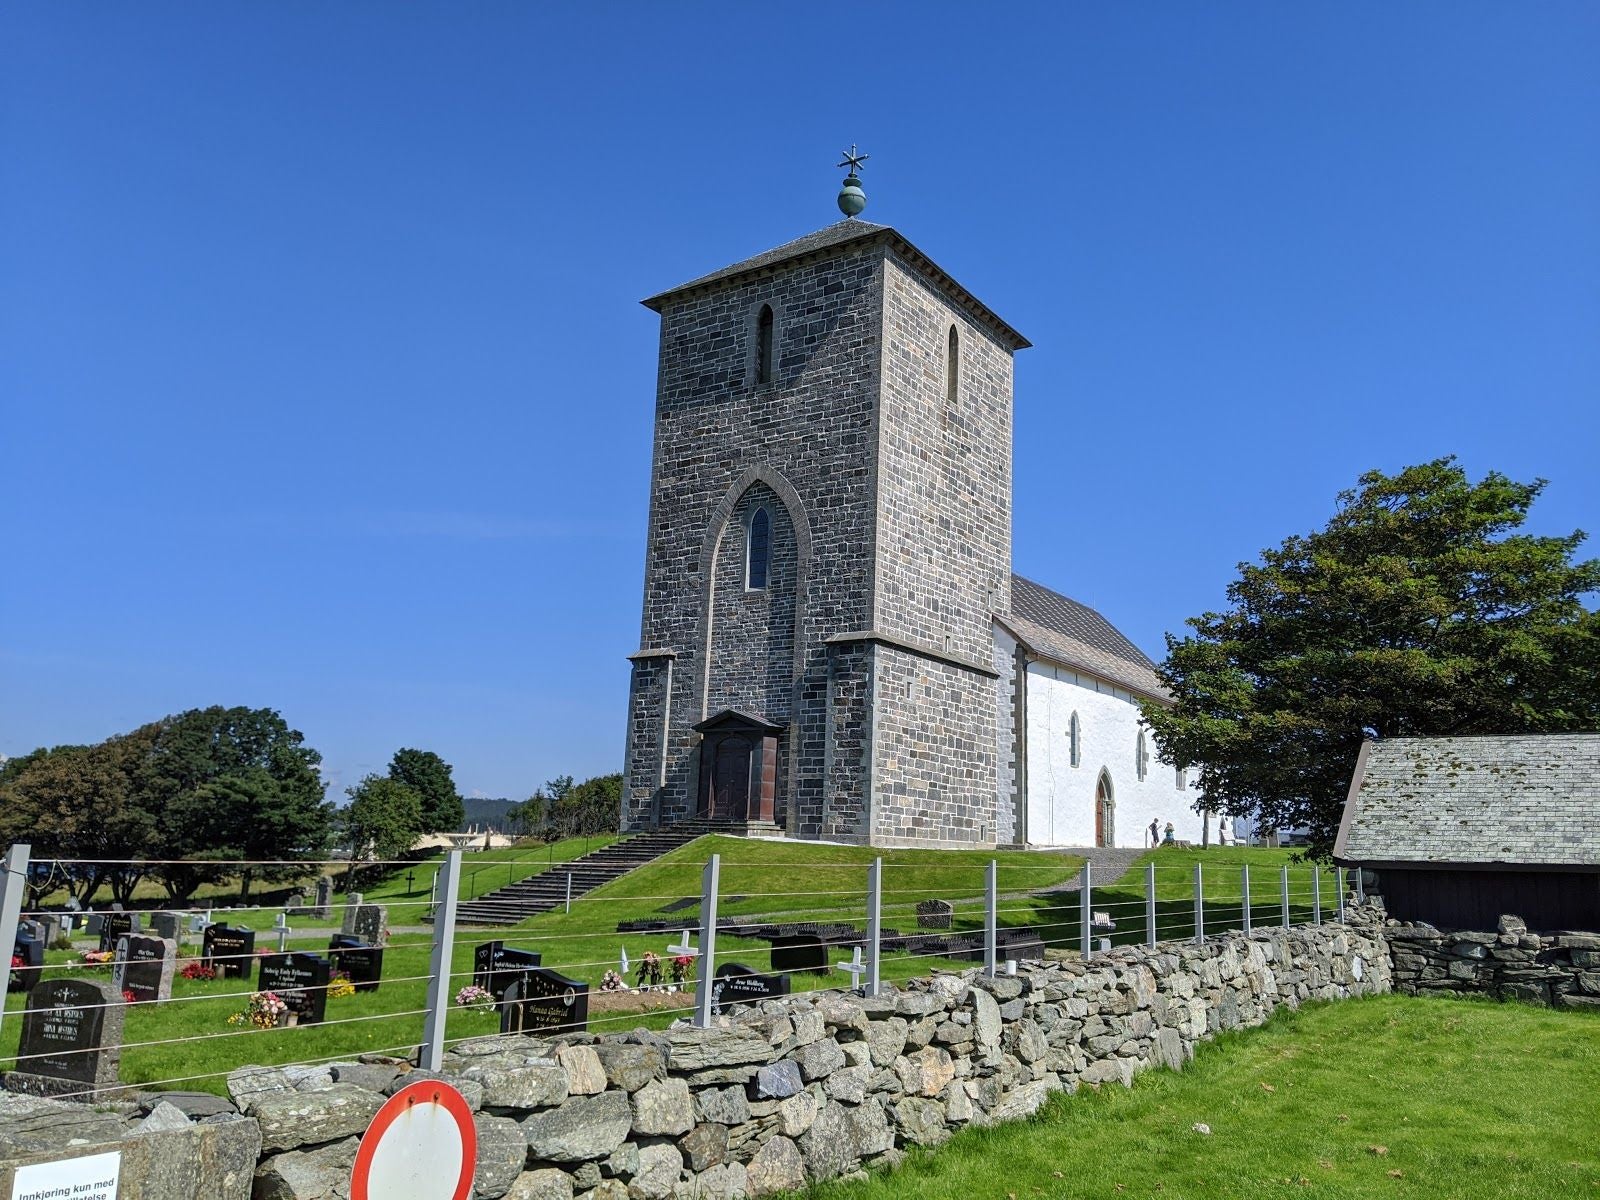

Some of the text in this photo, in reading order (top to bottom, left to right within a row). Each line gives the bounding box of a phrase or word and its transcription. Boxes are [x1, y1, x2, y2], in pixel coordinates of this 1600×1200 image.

[19, 1177, 115, 1200] Innkjøring kun med
